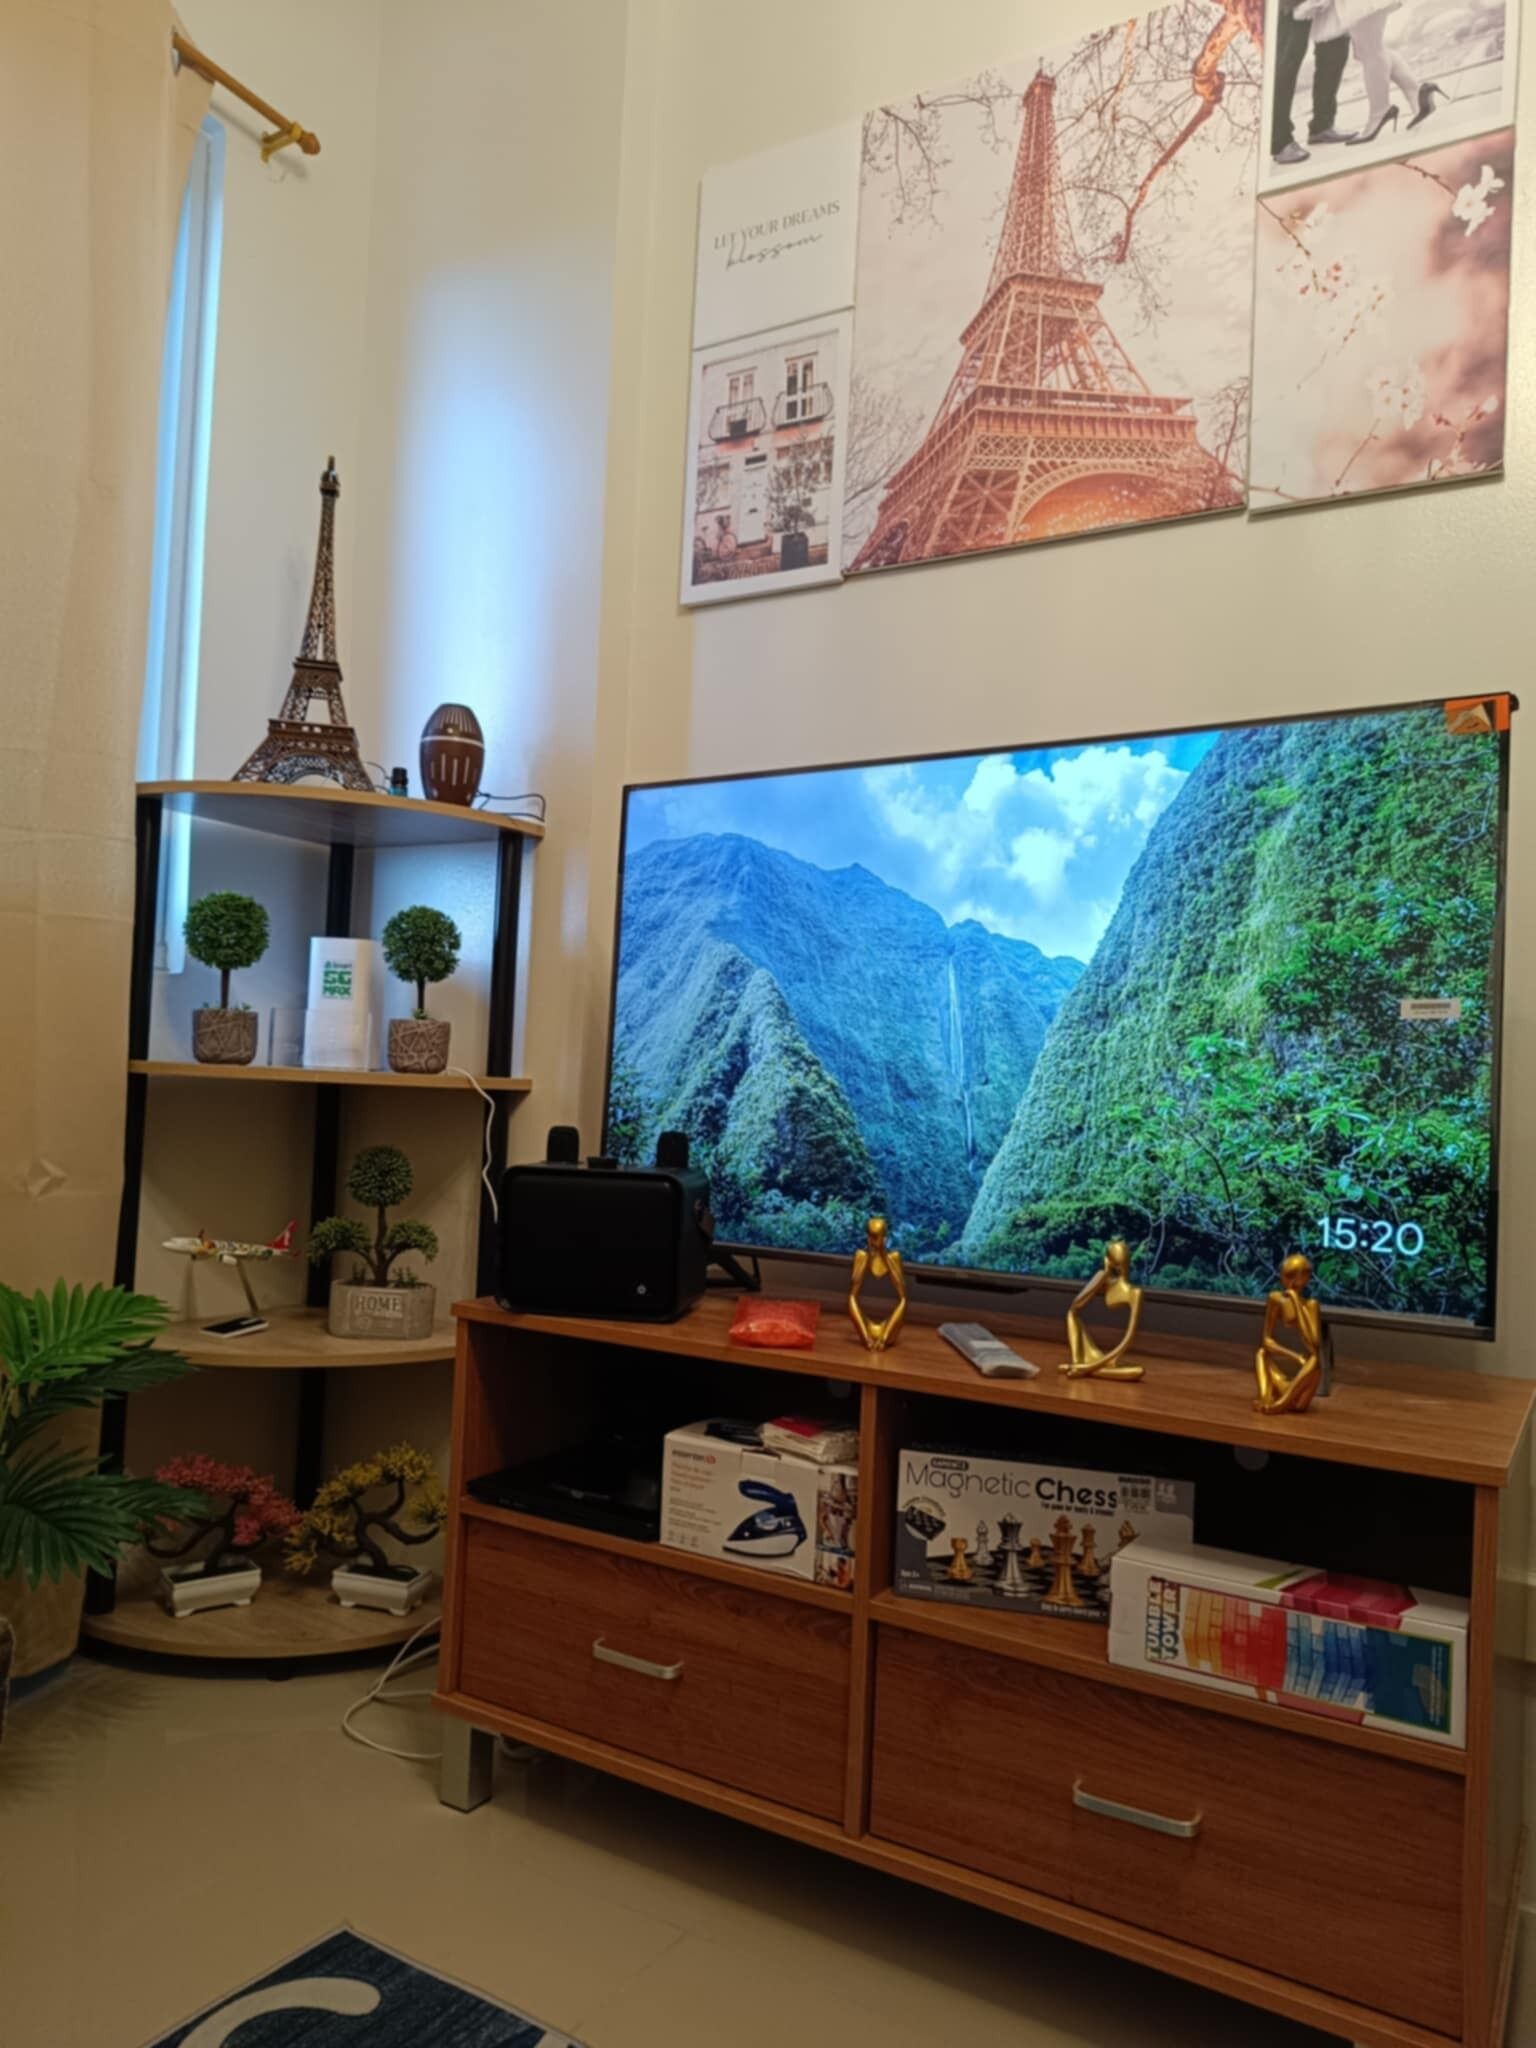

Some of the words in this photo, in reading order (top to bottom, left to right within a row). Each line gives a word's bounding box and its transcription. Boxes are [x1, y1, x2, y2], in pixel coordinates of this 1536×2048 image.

[740, 218, 779, 243] YOUR
[782, 199, 840, 230] DREAMS
[323, 970, 353, 985] 5G
[1317, 1215, 1424, 1256] 15:20
[355, 1295, 402, 1312] HOME
[905, 1461, 1031, 1498] Magnetic
[1034, 1476, 1118, 1509] Chess
[1146, 1579, 1161, 1662] TUMBLE
[1160, 1587, 1177, 1660] TOWER
